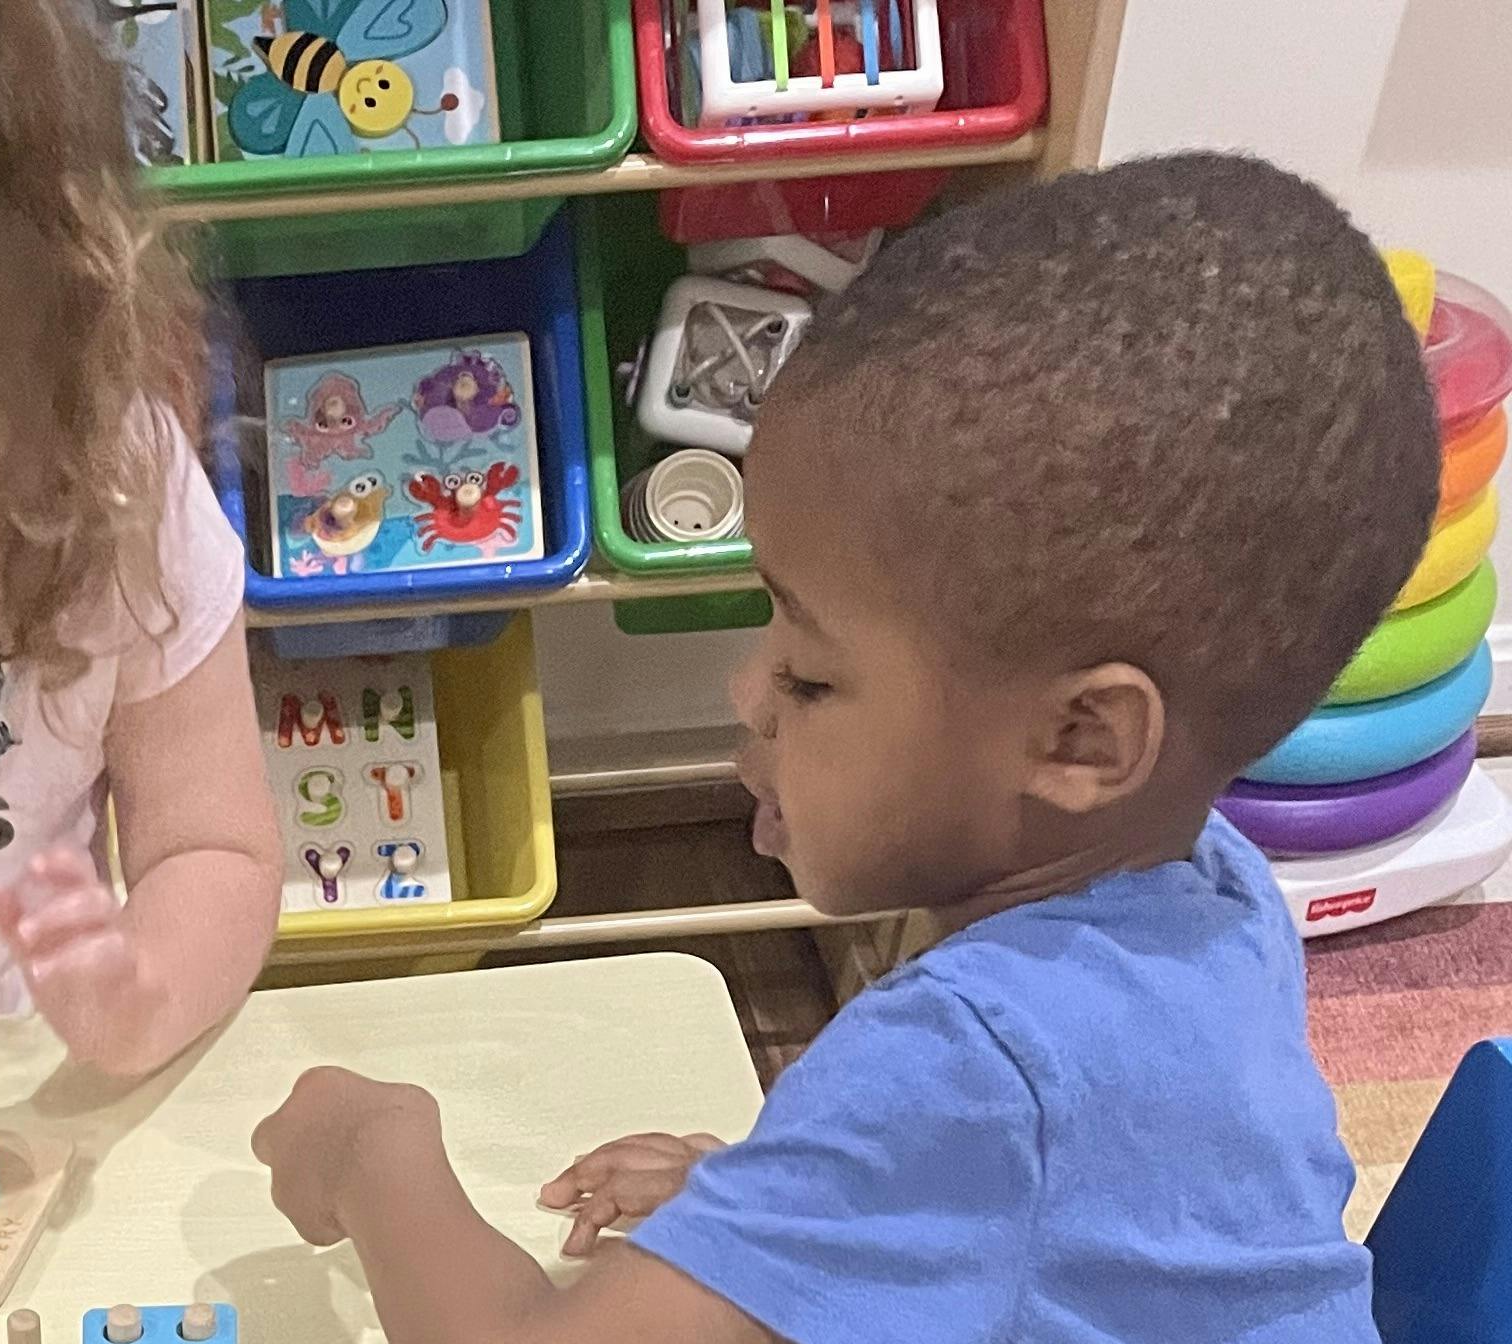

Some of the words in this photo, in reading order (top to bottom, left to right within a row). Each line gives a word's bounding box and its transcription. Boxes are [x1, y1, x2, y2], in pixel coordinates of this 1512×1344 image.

[278, 692, 345, 748] M
[362, 686, 414, 742] N
[298, 770, 342, 826] S
[370, 763, 416, 821] T
[305, 846, 351, 902] Y
